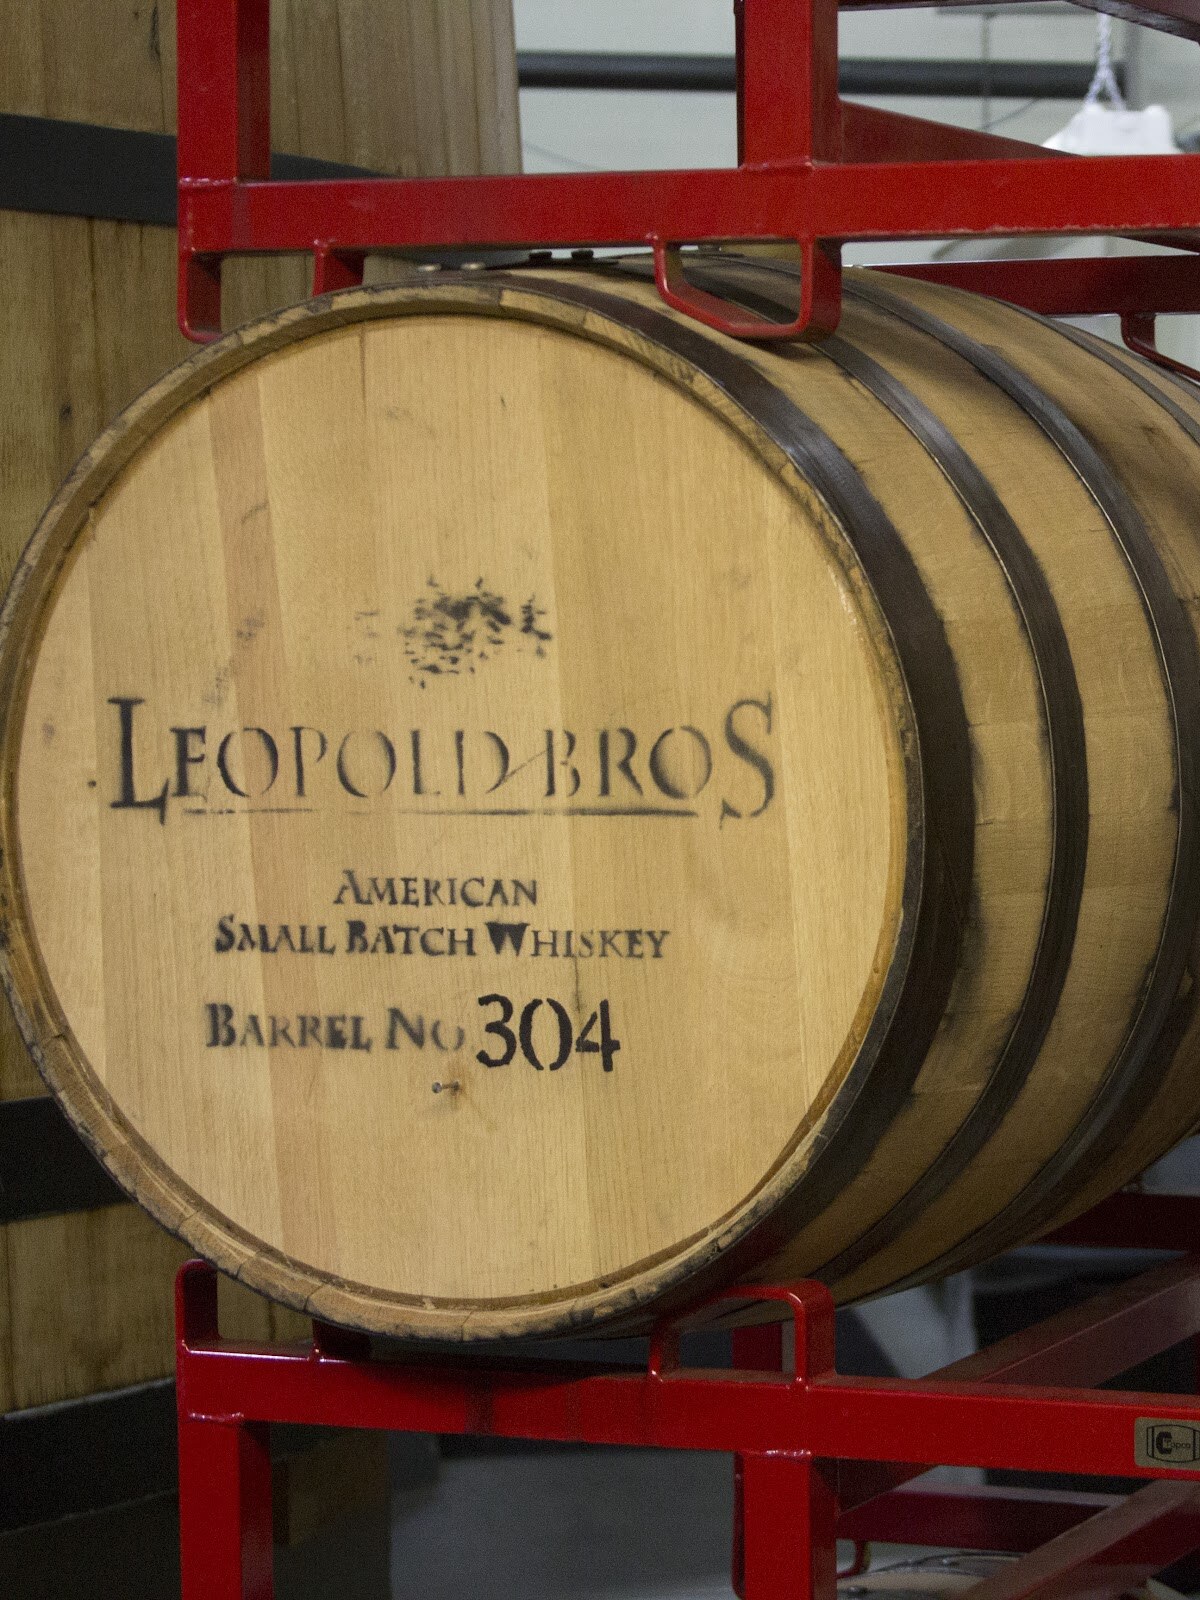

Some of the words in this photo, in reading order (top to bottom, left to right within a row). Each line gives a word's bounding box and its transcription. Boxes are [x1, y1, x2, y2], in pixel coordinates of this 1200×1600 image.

[106, 696, 511, 826] LEOPOLD
[543, 692, 776, 829] BROS
[333, 869, 538, 908] AMERICAN
[214, 914, 336, 956] SMALL
[345, 919, 477, 957] BATCH
[480, 920, 671, 960] WHISKEY
[204, 1002, 373, 1053] BARREL
[475, 993, 622, 1074] 304
